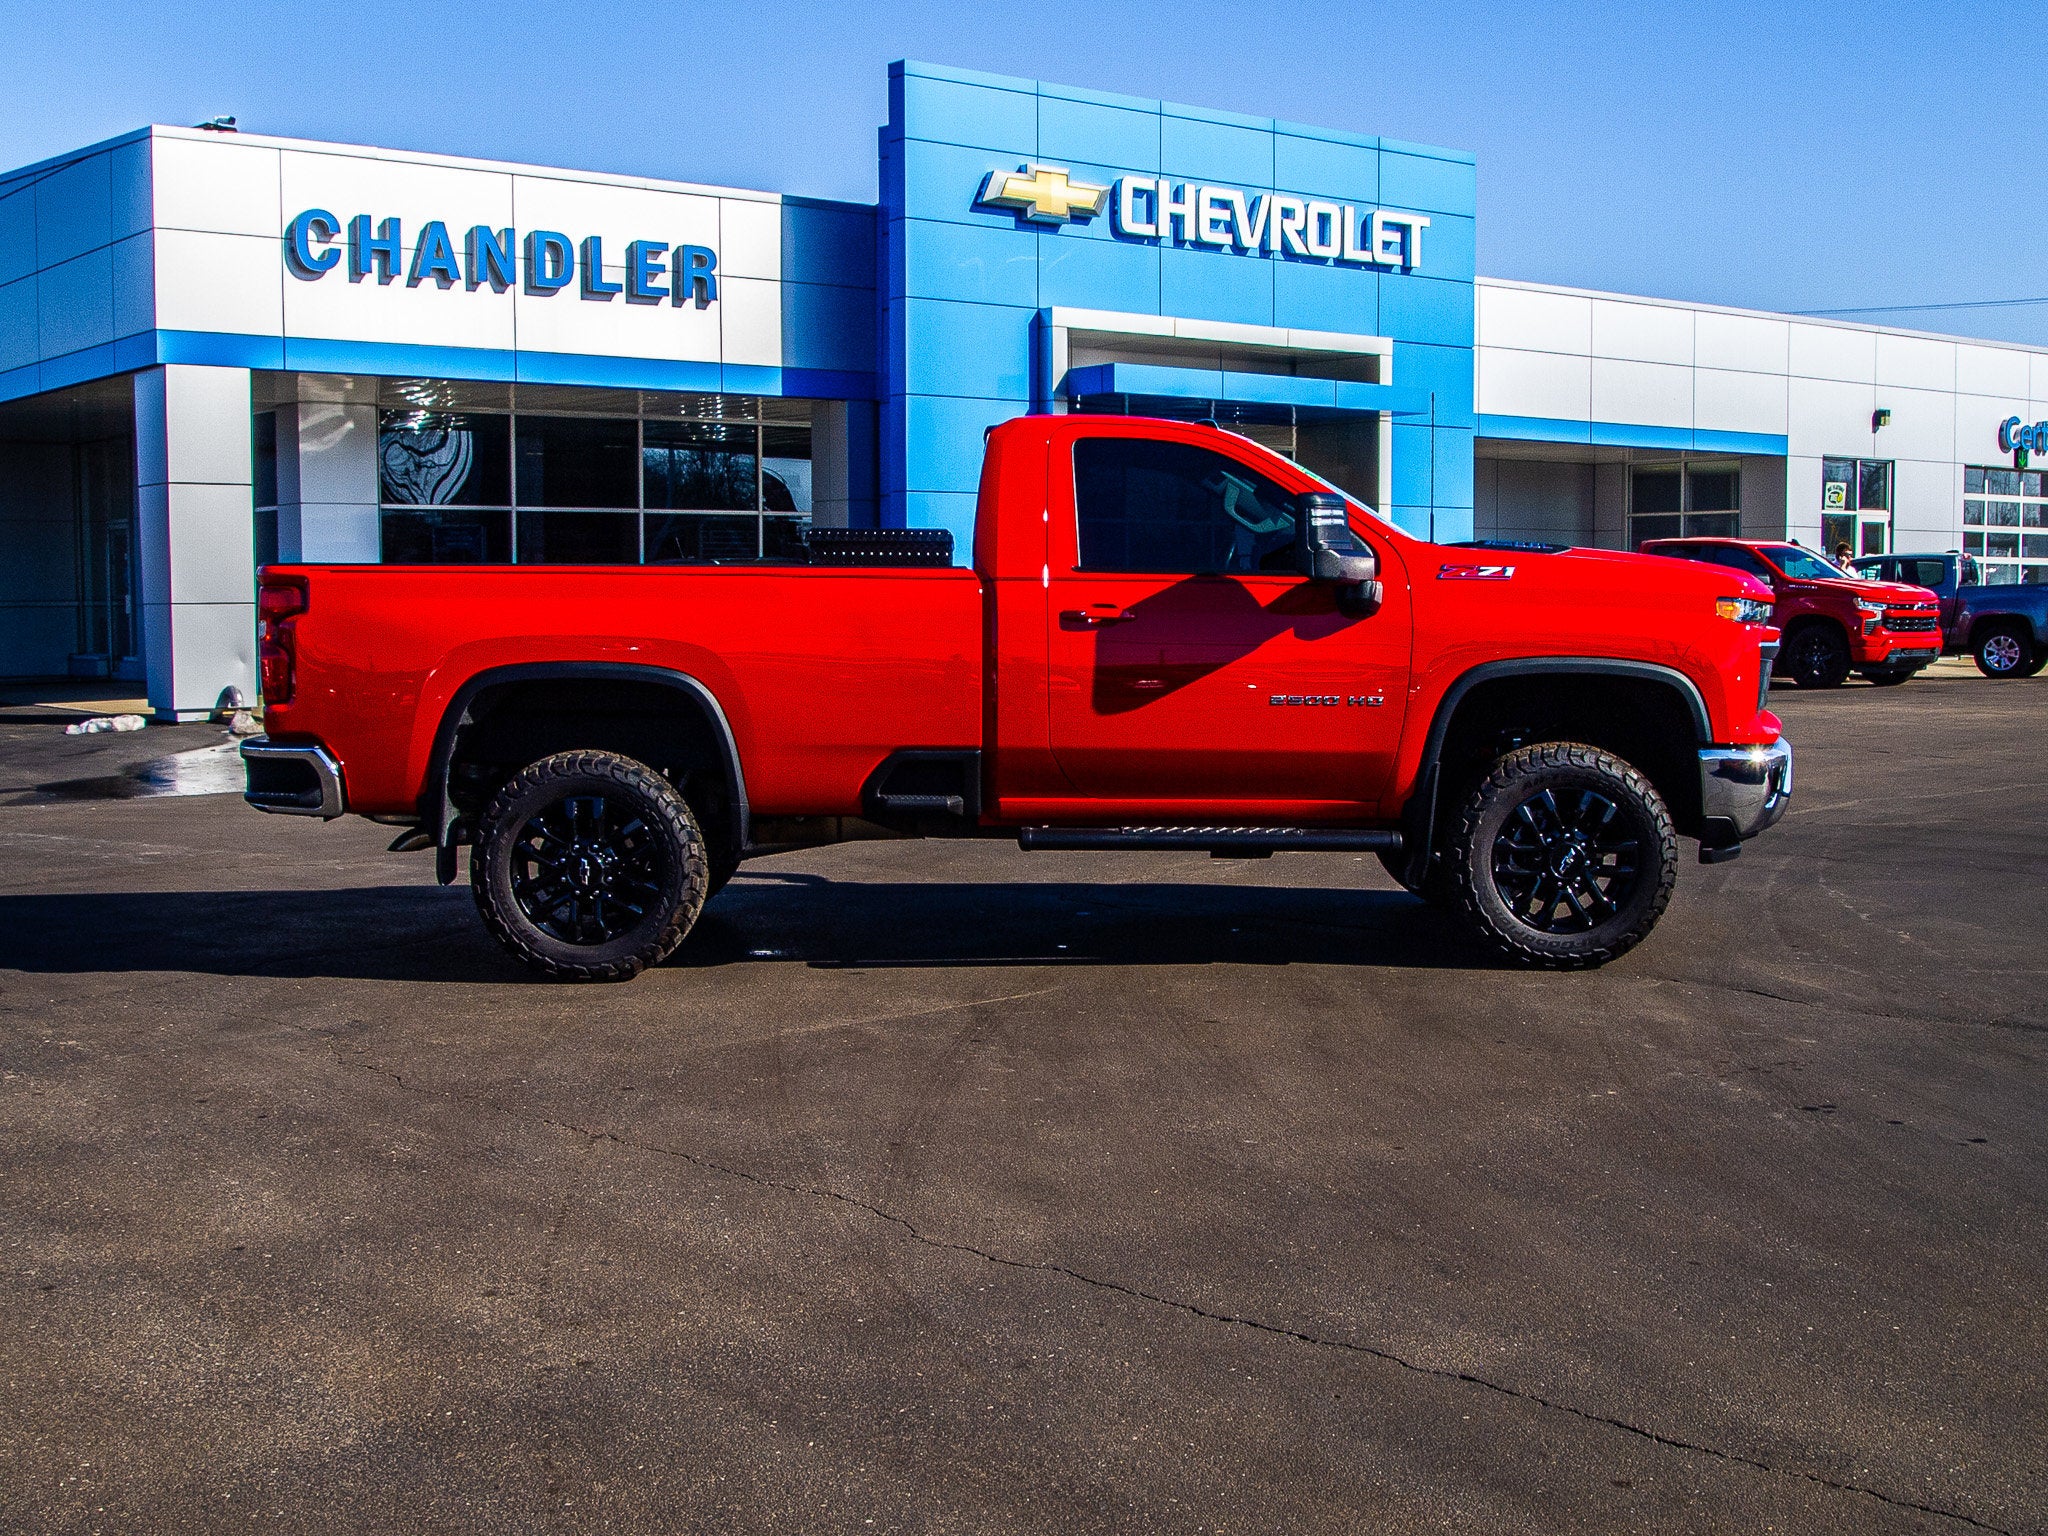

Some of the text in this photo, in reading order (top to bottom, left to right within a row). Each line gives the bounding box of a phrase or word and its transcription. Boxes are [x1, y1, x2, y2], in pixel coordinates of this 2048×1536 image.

[1113, 176, 1430, 271] CHEVROLET
[287, 208, 718, 307] CHANDLER
[1437, 564, 1515, 580] Z71
[1270, 695, 1384, 706] 2500 HD
